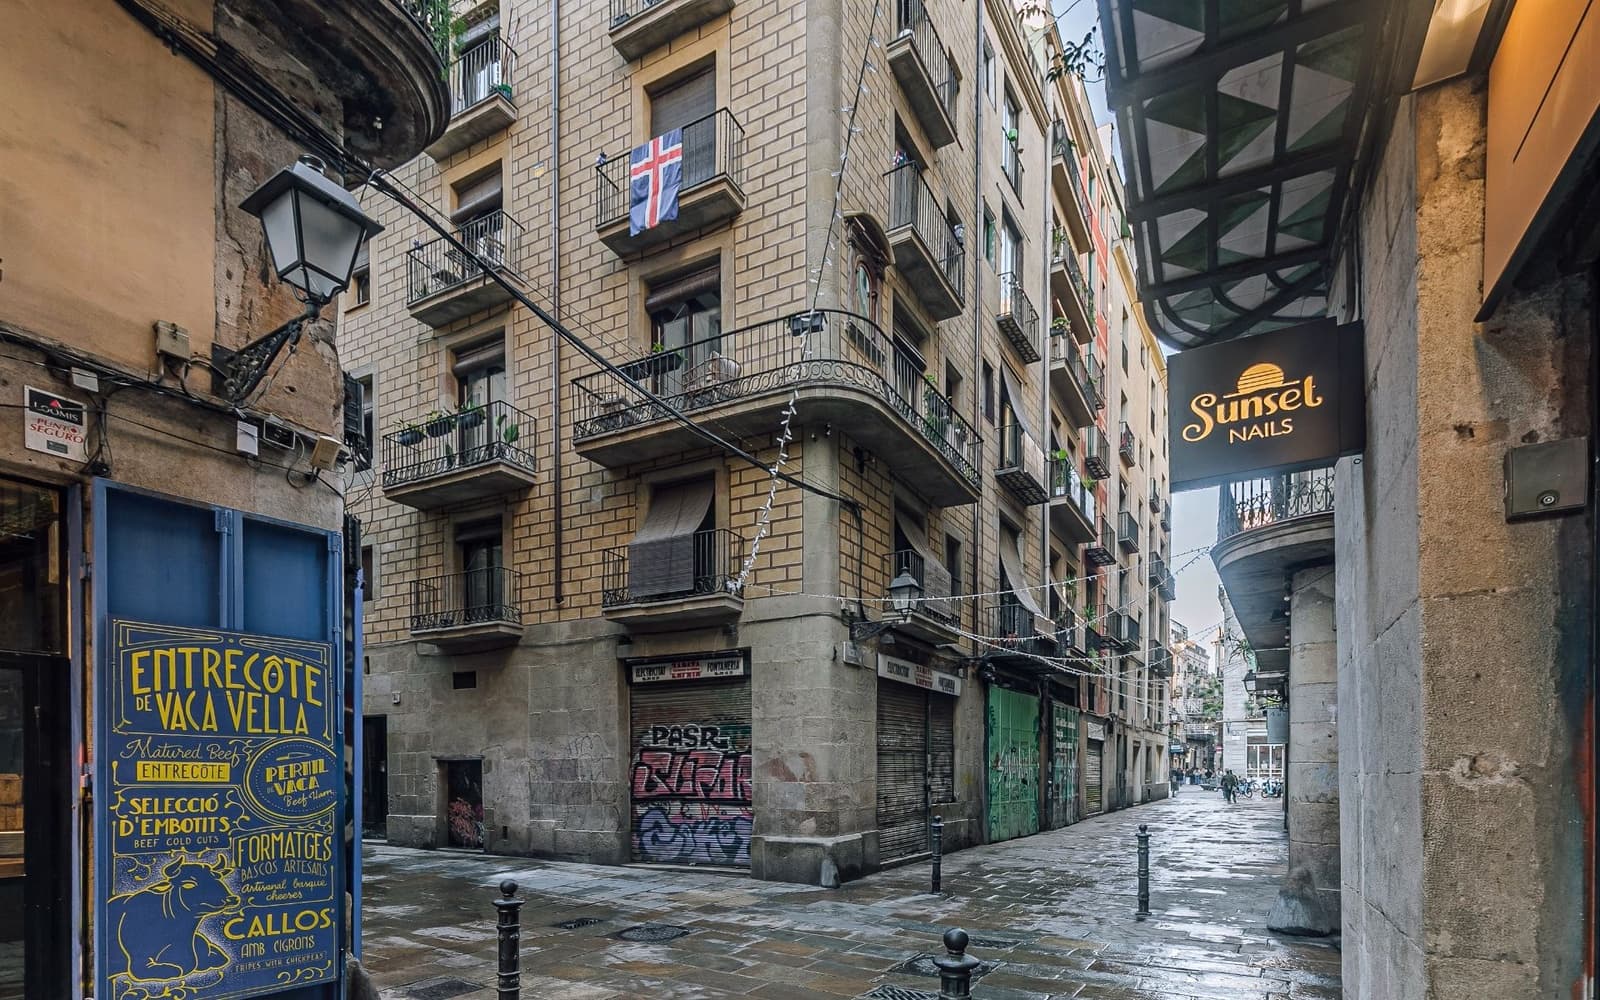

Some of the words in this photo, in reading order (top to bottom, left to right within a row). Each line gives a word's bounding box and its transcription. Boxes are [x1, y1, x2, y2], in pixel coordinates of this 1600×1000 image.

[33, 401, 79, 421] LOOMIS
[1182, 375, 1324, 442] Sunset
[30, 423, 84, 444] SEGURO
[1229, 418, 1294, 444] NAILS
[131, 647, 323, 707] ENTRECÔTE
[136, 695, 152, 712] DE
[155, 691, 218, 732] VACA
[226, 690, 309, 735] VELLA
[120, 736, 202, 759] Matured
[206, 743, 240, 768] Beef
[274, 776, 320, 796] VACA
[129, 792, 219, 815] SELECCIÓ
[284, 793, 308, 807] Beef
[120, 816, 230, 837] D'EMBOTITS
[134, 838, 159, 848] BEEF
[166, 837, 191, 846] COLD
[197, 836, 219, 844] CUTS
[238, 831, 332, 867] FORMATGES
[241, 860, 277, 882] BASCOS
[284, 859, 328, 877] ARTESANS
[241, 942, 265, 958] AMB
[273, 935, 315, 953] CIGRONS
[266, 959, 282, 968] WITH
